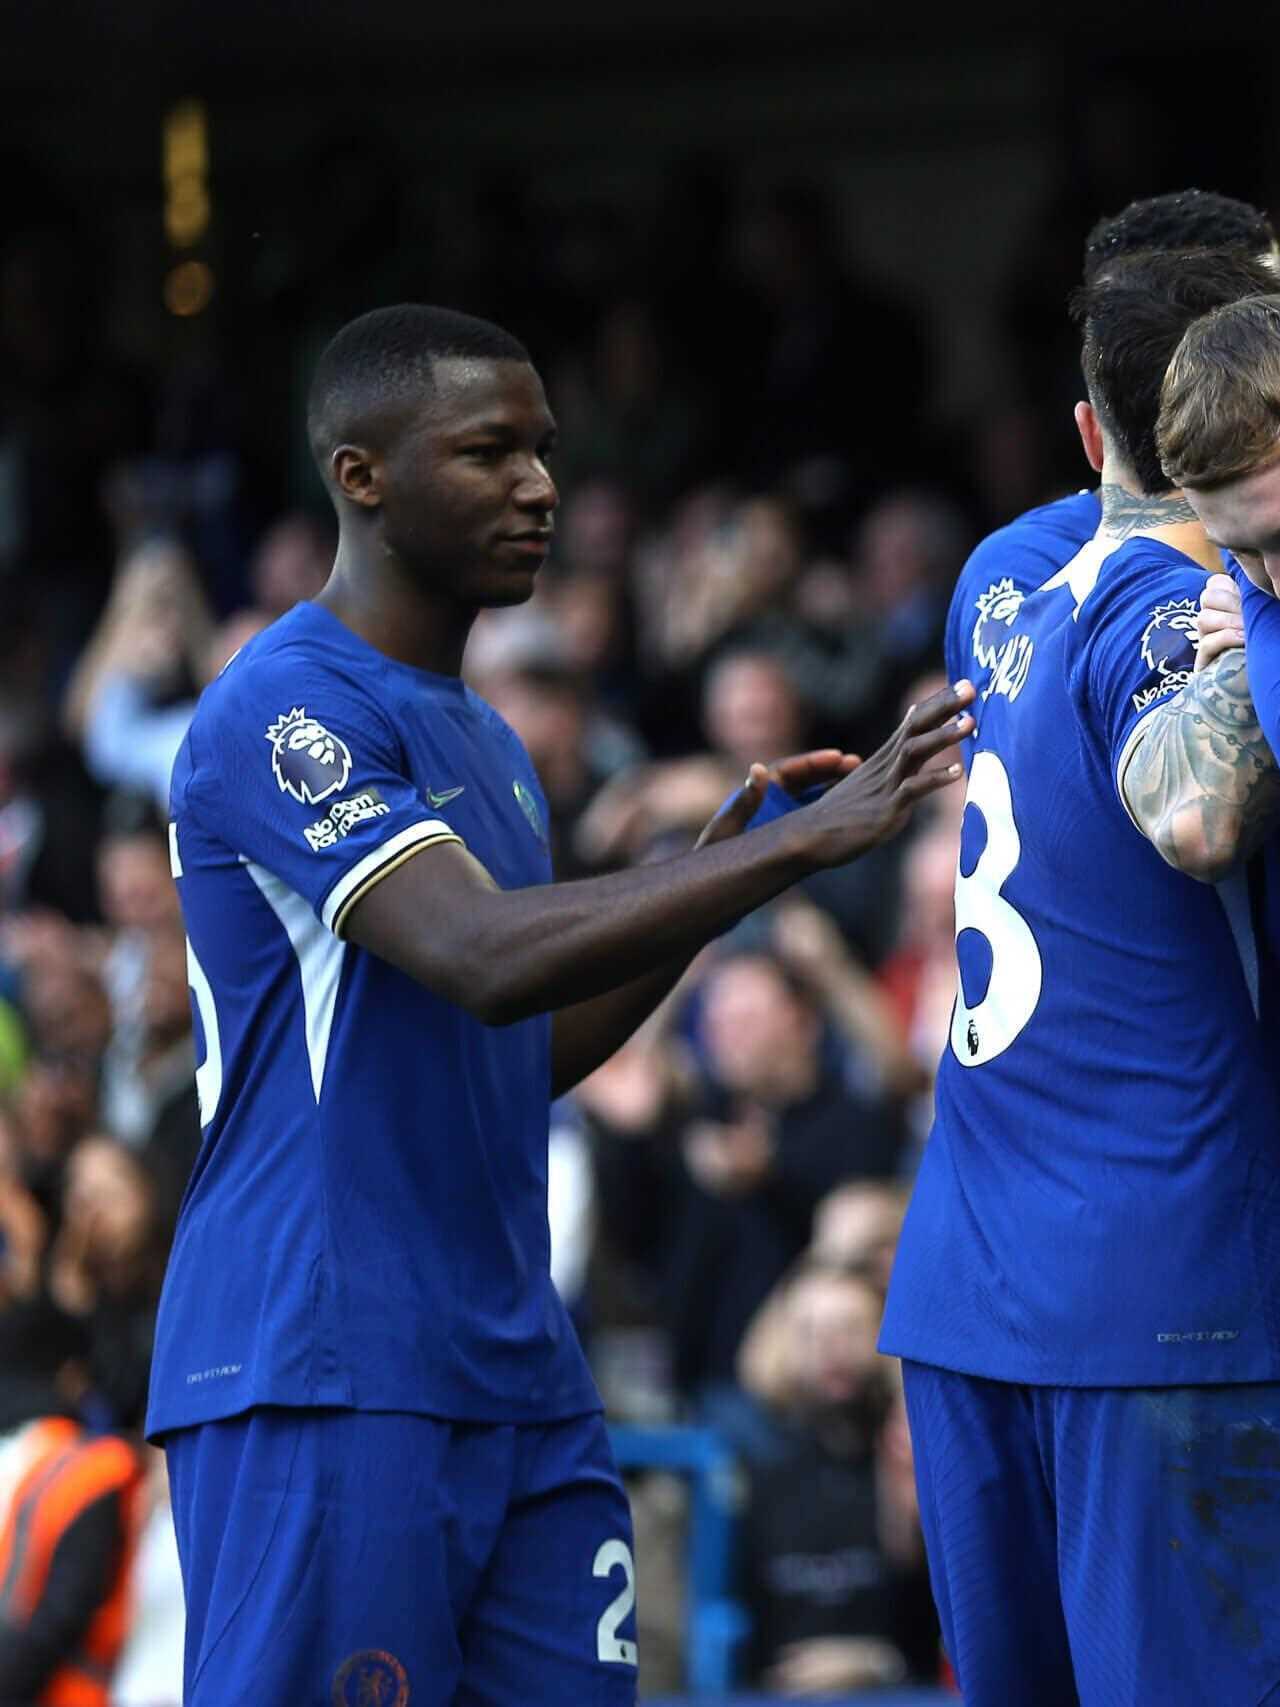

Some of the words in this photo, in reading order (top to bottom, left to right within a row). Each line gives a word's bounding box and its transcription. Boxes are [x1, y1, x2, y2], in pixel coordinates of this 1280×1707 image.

[303, 818, 333, 846] No
[949, 750, 1043, 1068] 8
[592, 1539, 638, 1667] 2
